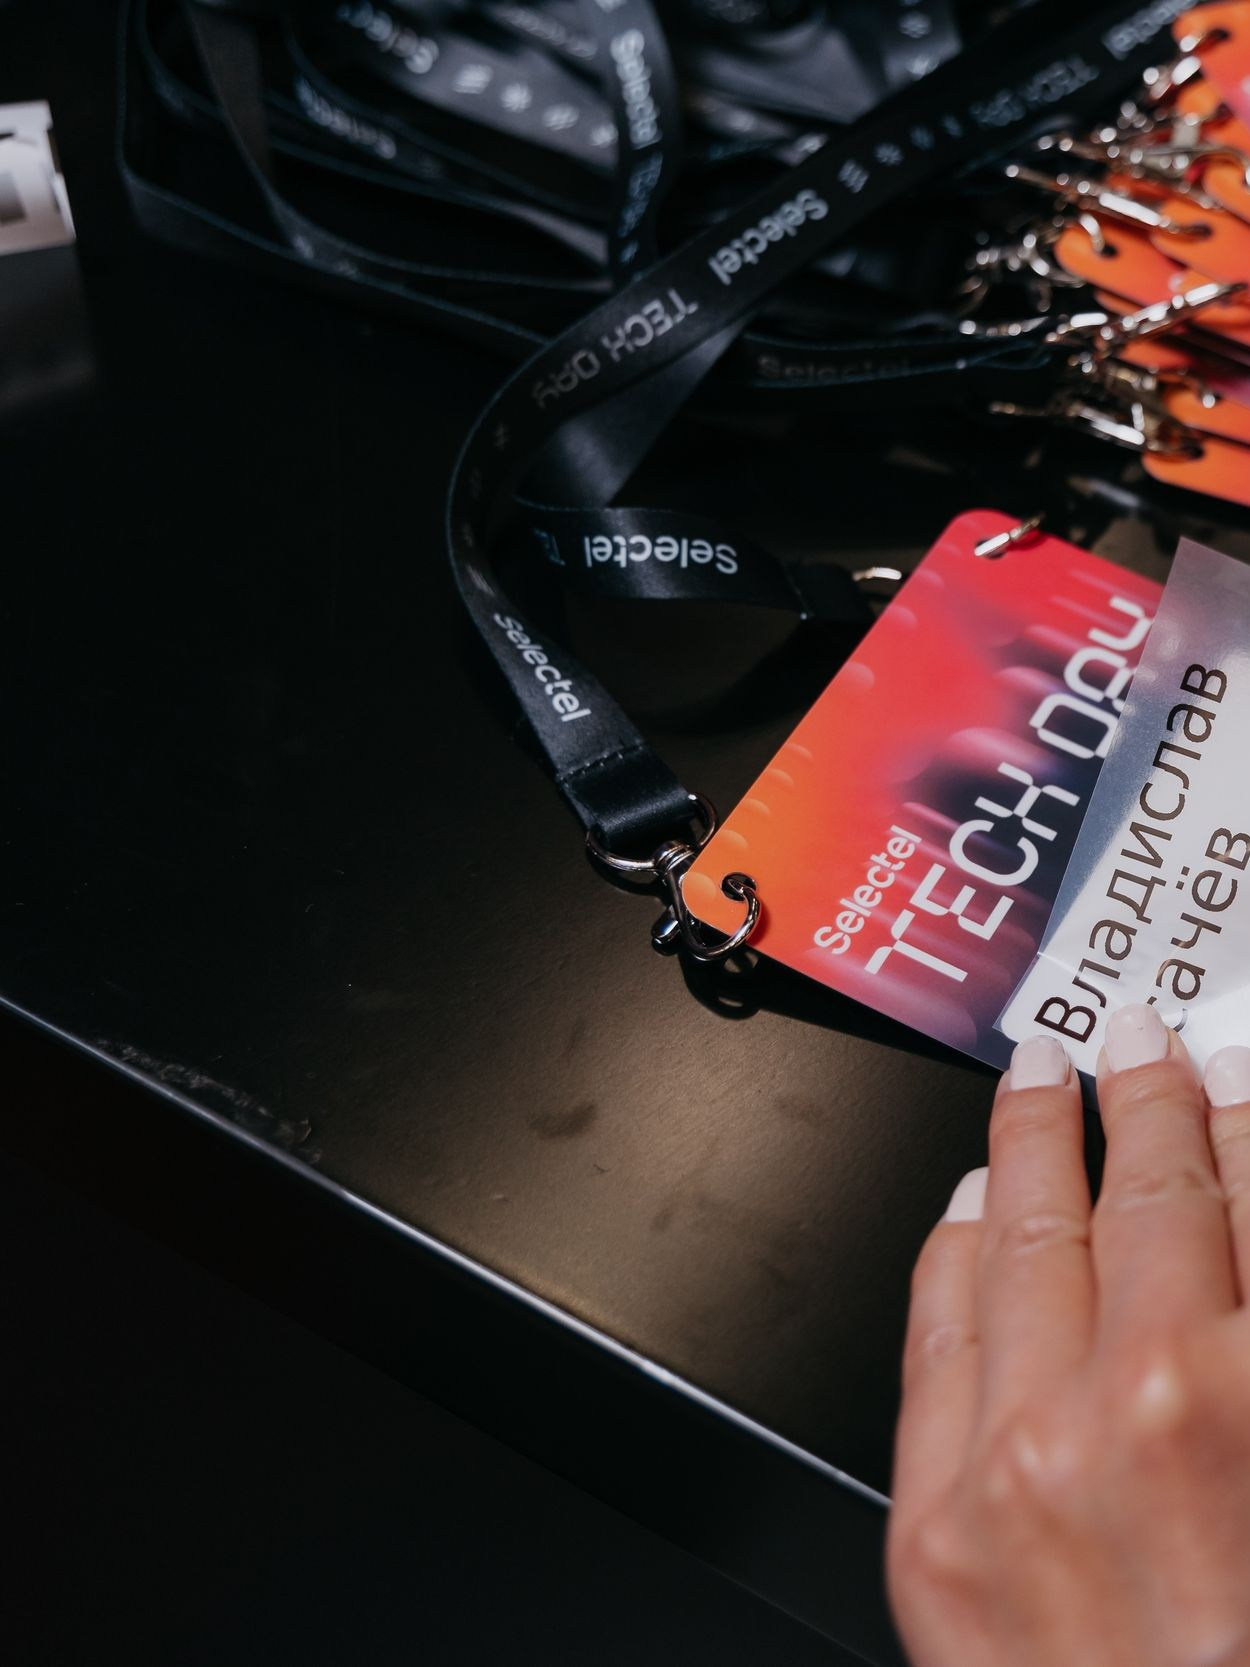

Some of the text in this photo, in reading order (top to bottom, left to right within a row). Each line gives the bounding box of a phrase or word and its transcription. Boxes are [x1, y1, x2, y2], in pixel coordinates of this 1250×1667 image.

[707, 188, 829, 286] Selectel
[602, 288, 699, 363] TECH
[584, 535, 738, 575] Selectel
[494, 611, 592, 722] Selectel
[813, 824, 922, 956] Selectel
[864, 762, 1081, 983] TECH
[1034, 662, 1229, 1044] Владислав
